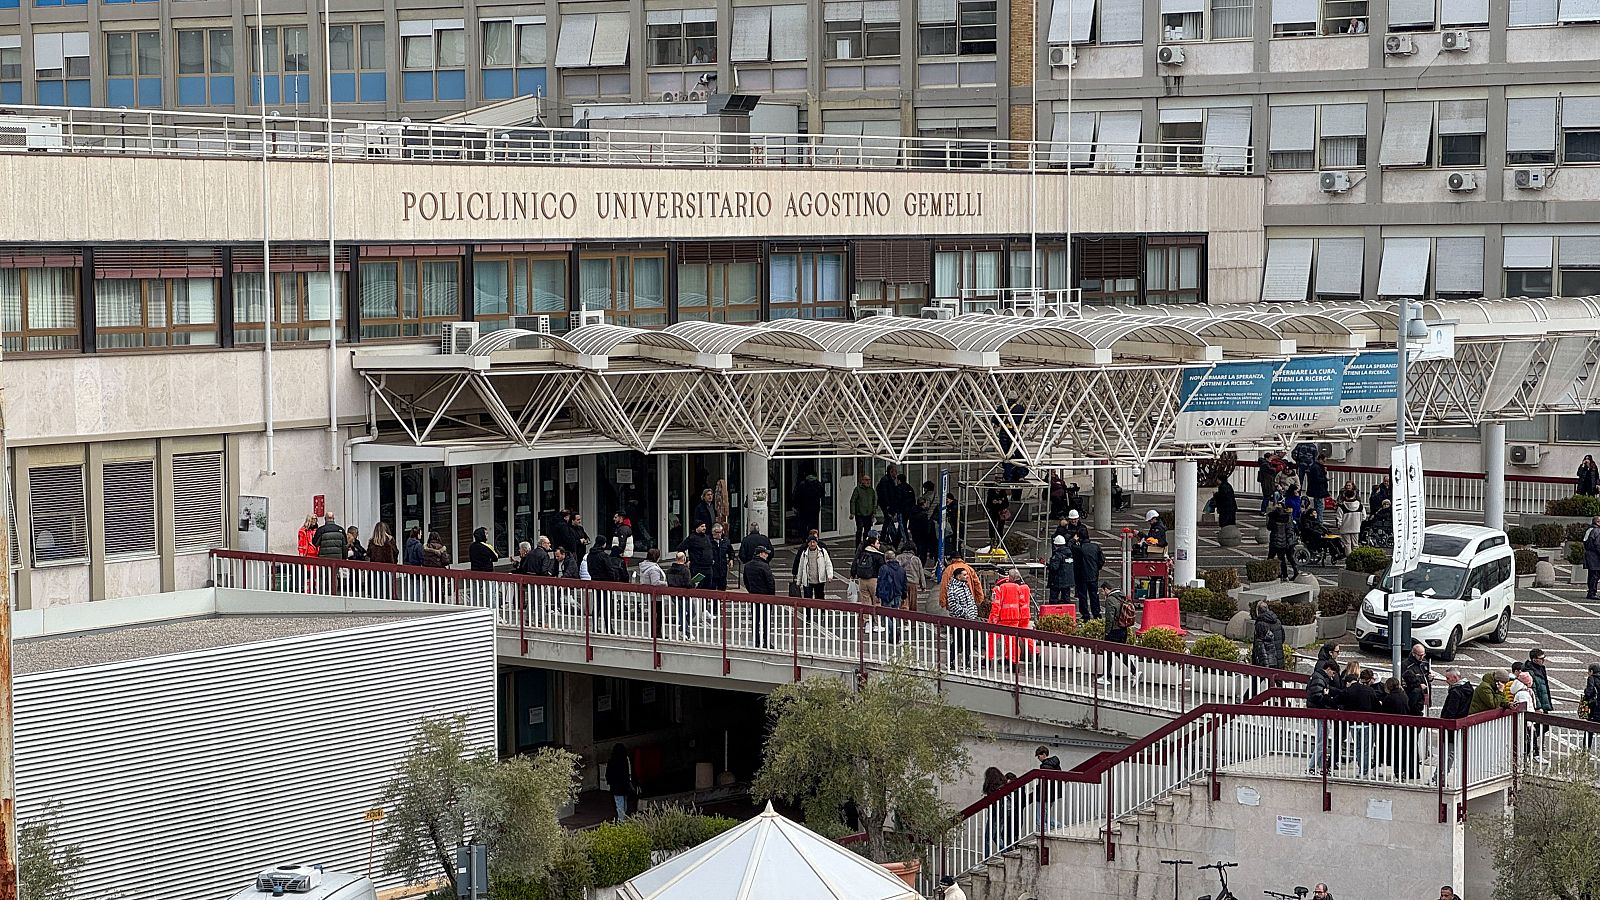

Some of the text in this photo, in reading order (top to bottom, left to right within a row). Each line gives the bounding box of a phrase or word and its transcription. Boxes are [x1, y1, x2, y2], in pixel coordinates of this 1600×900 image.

[401, 191, 983, 221] POLICLINICO UNIVERSITARIO AGOSTINO GEMELLI
[1394, 498, 1402, 564] Gemelli
[1409, 494, 1418, 560] Gemelli
